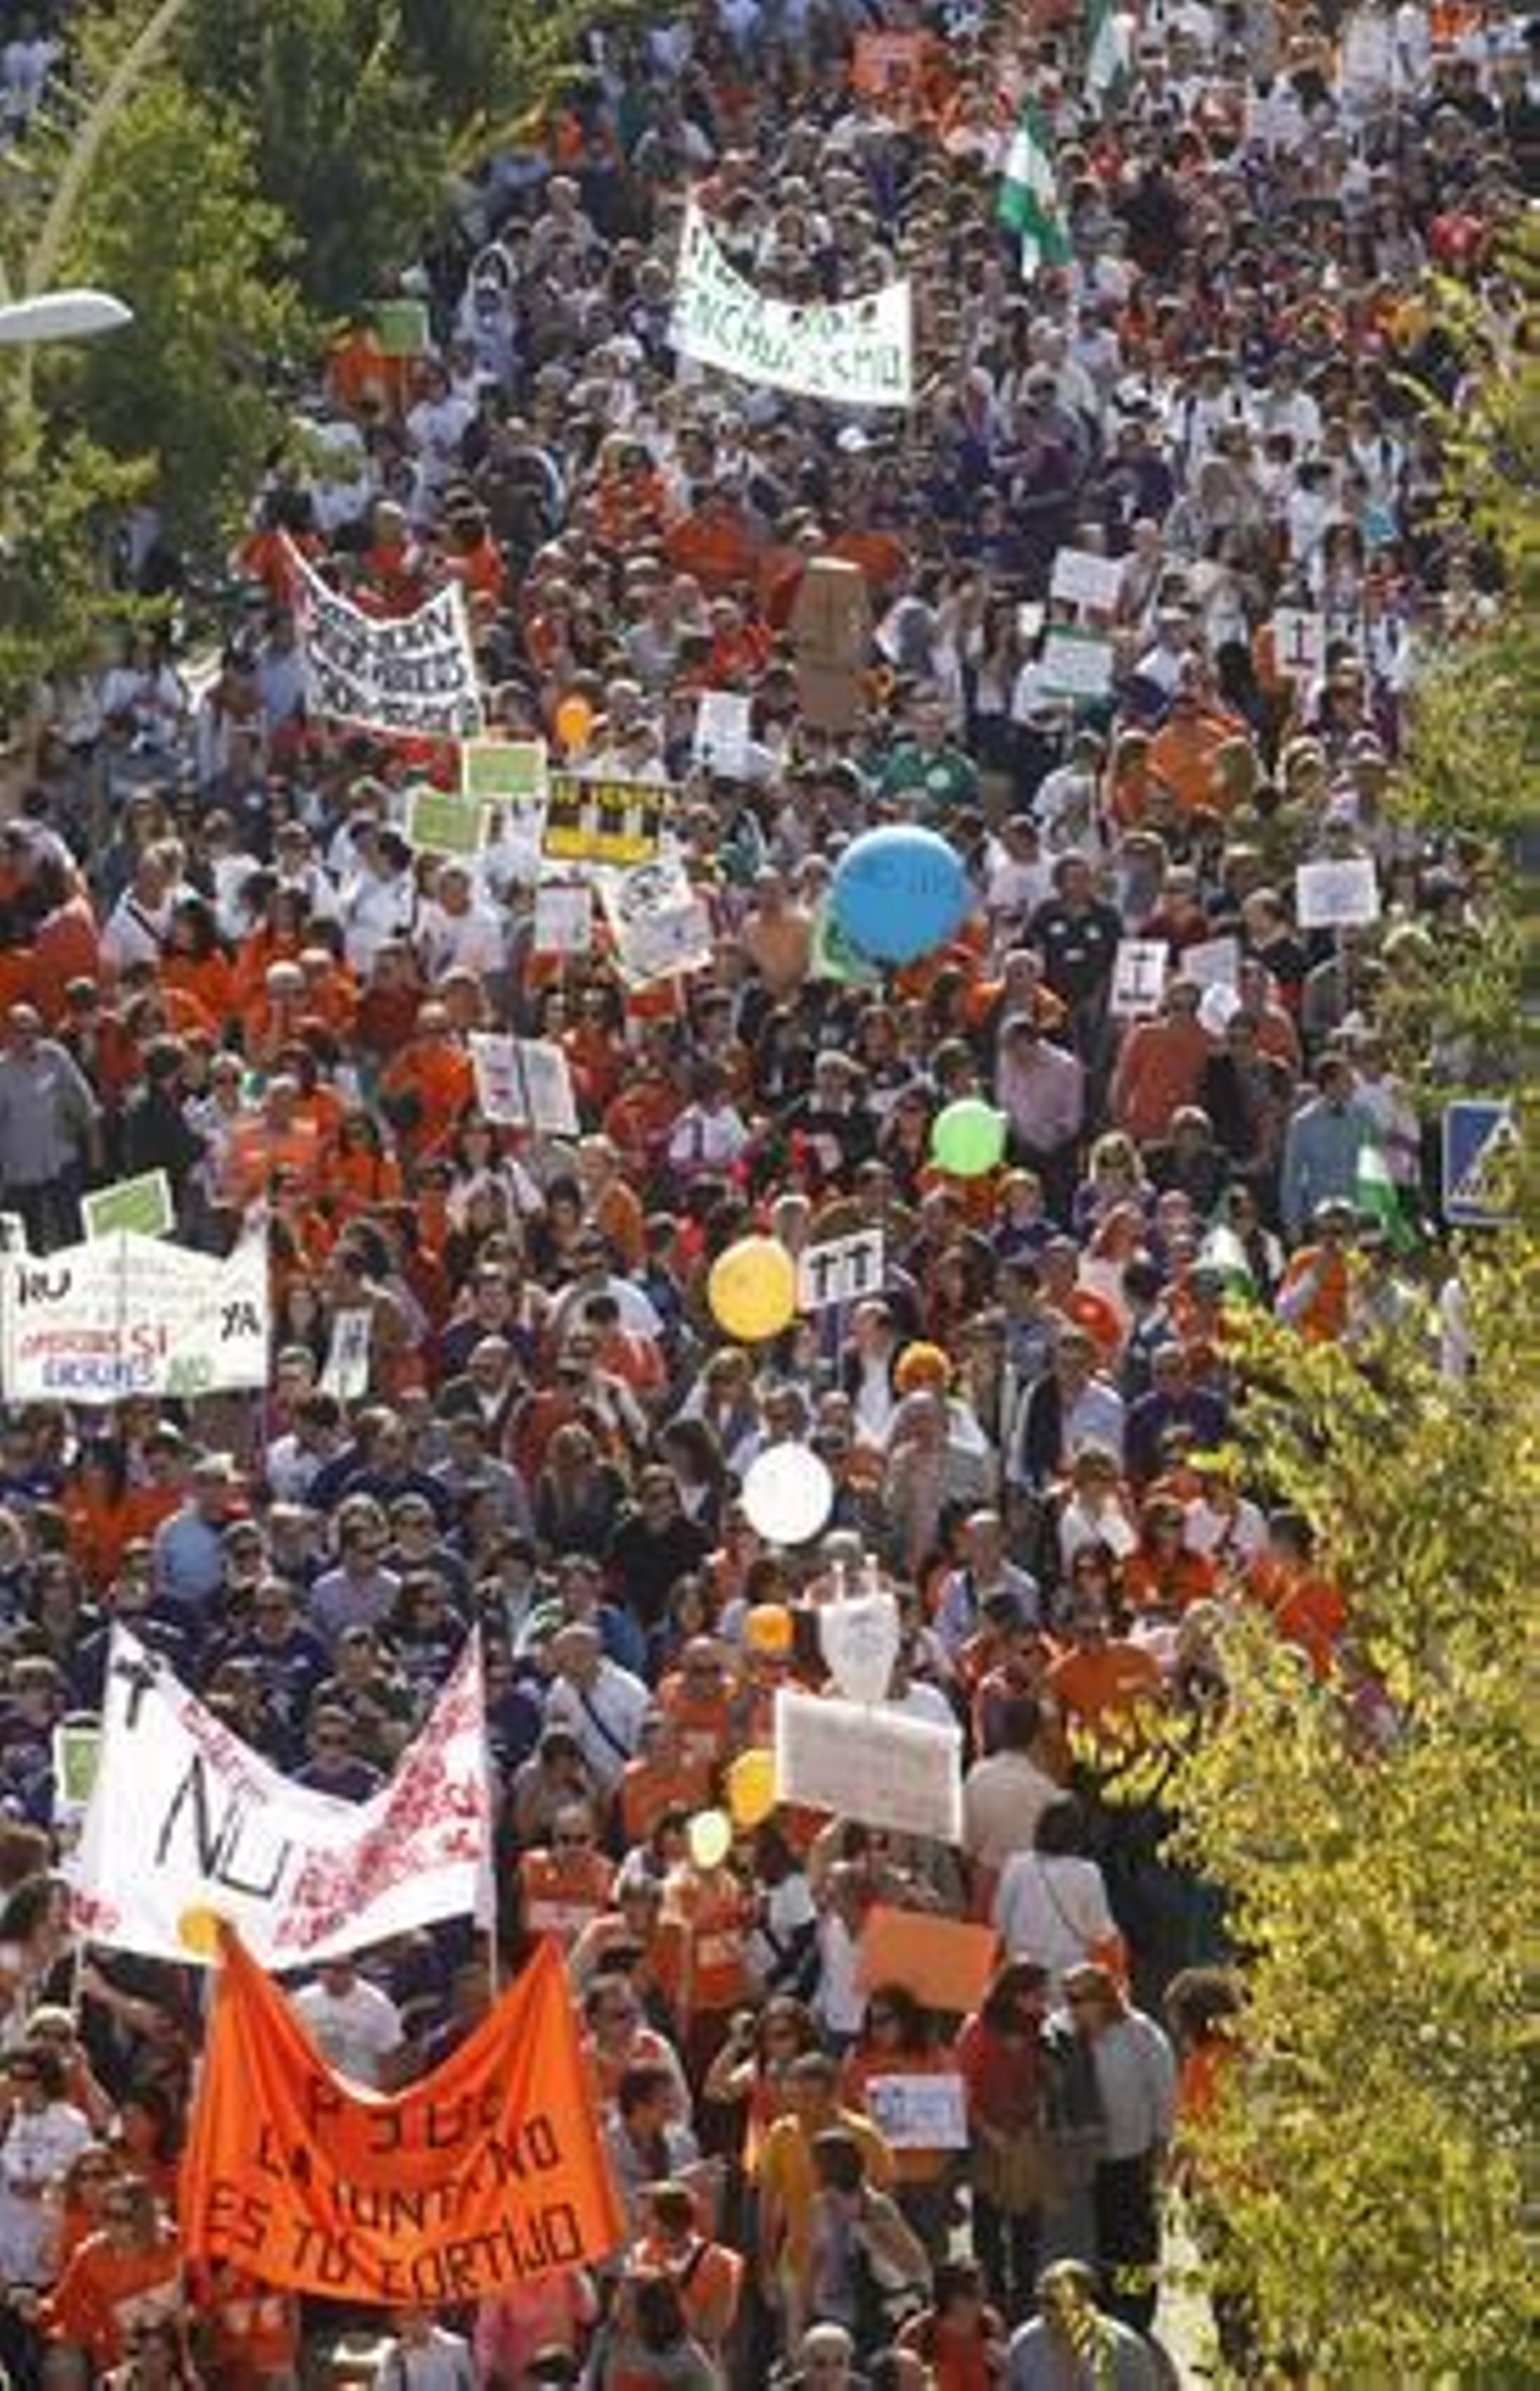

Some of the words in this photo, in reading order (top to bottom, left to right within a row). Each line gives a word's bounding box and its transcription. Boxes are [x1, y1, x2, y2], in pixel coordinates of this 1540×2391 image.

[154, 1754, 293, 1899] NO
[484, 2115, 560, 2187] NO
[204, 2179, 271, 2253] ES
